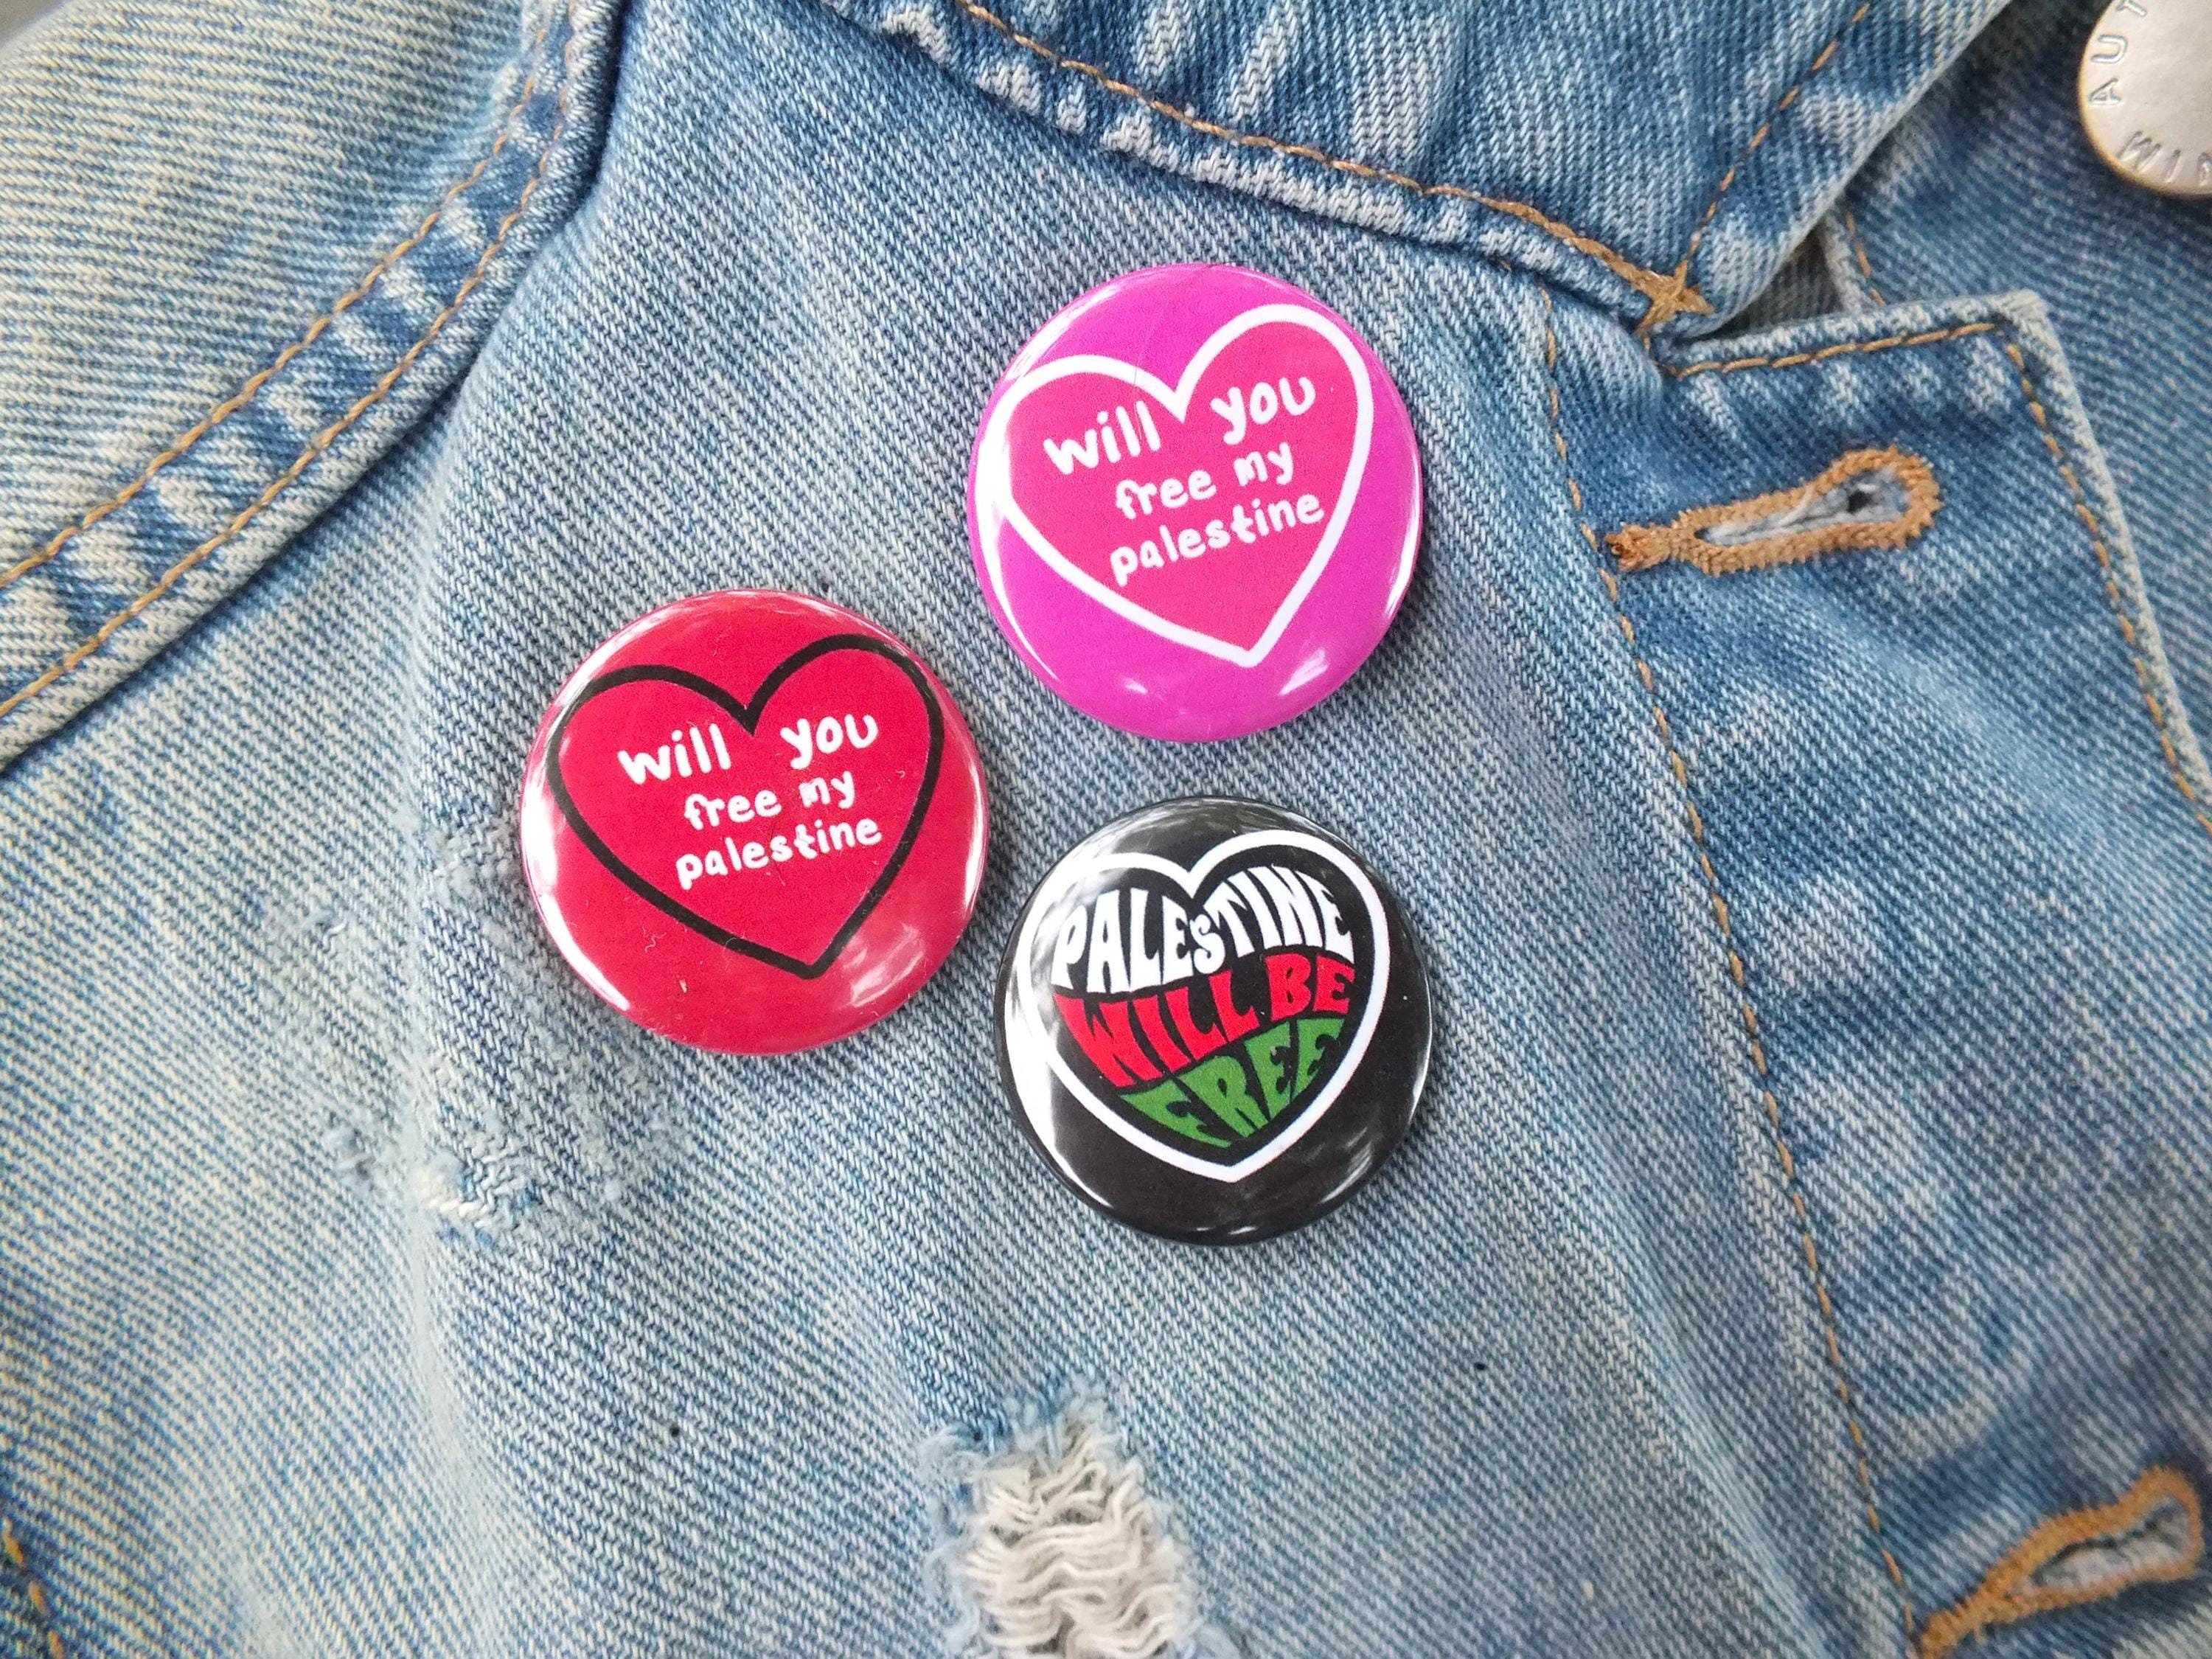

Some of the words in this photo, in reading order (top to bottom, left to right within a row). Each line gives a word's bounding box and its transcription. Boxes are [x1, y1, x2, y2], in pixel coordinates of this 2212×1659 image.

[1044, 400, 1161, 475] will
[1211, 377, 1315, 445] you
[1116, 470, 1217, 519] free
[1234, 442, 1293, 486] my
[1110, 494, 1324, 587] palestine
[618, 724, 731, 784] will
[781, 714, 878, 769] you
[684, 790, 782, 830] free
[799, 771, 855, 808] my
[676, 818, 881, 889] palestine
[1054, 971, 1259, 1087] WILL
[1265, 953, 1354, 1020] BE
[1121, 1018, 1344, 1147] FREE
